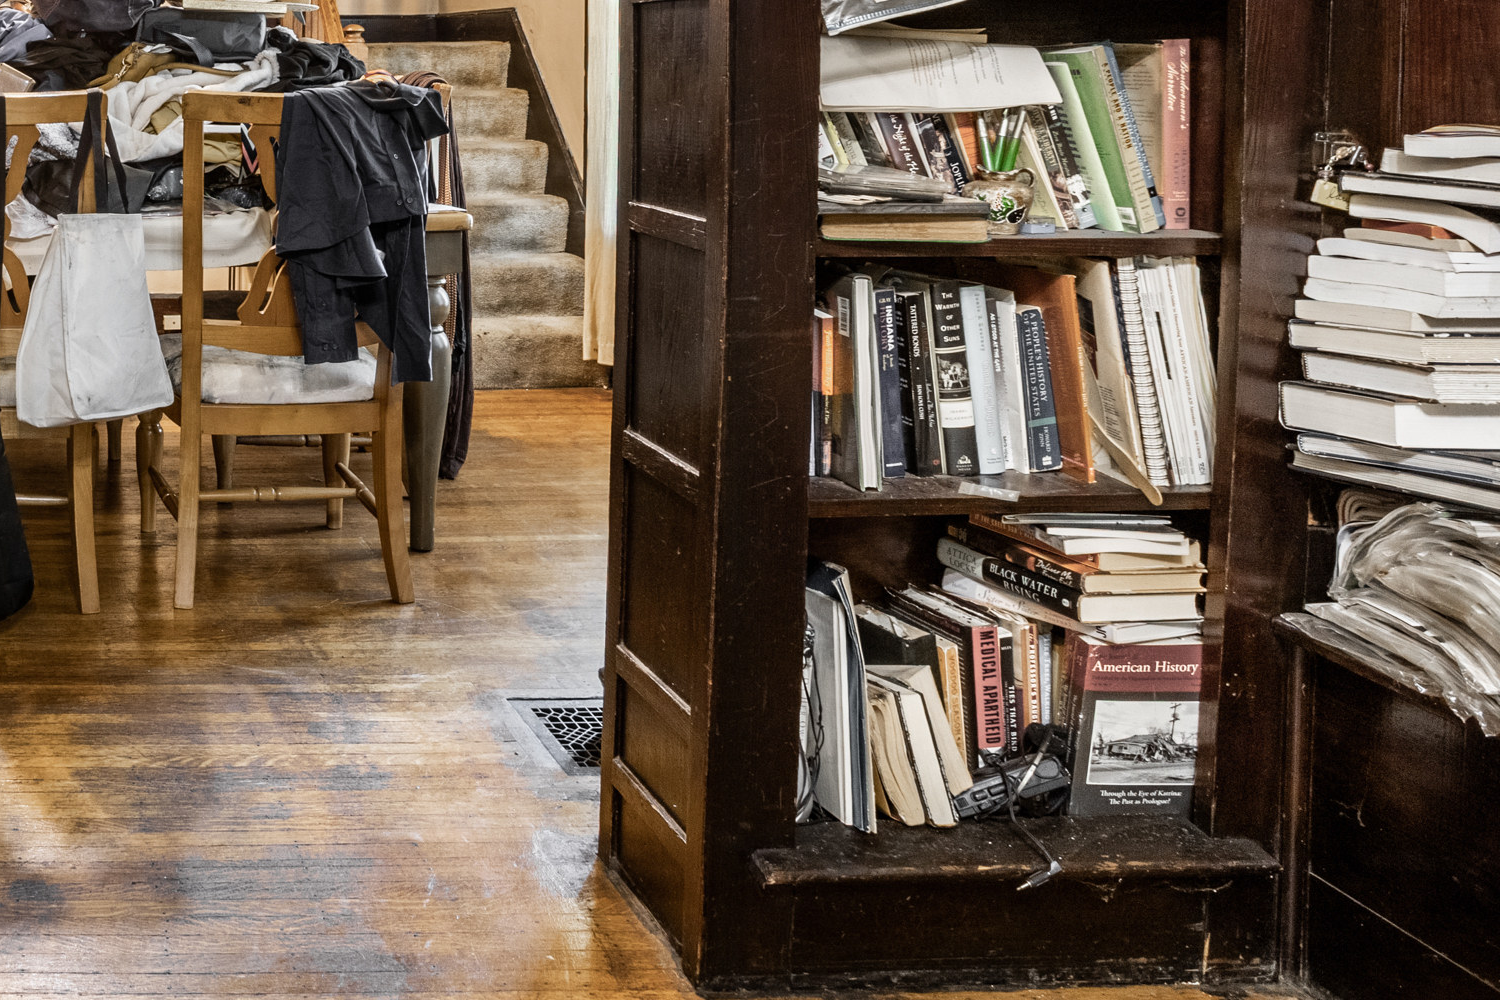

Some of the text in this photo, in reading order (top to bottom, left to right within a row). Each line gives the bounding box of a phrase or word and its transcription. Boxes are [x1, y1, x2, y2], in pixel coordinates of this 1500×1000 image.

[1166, 62, 1179, 111] Narrative
[1179, 58, 1189, 130] Bondwoman's
[1105, 69, 1117, 95] PEOPLE
[1113, 98, 1122, 114] AND
[1119, 123, 1132, 149] NATION
[892, 124, 907, 145] Night
[903, 151, 913, 162] the
[909, 304, 919, 334] TATTERED
[934, 302, 960, 311] WARMTH
[990, 312, 996, 321] AS
[879, 306, 888, 351] HISTORY
[885, 305, 895, 351] INDIANA
[940, 324, 961, 333] OTHER
[943, 335, 961, 343] SUNS
[1031, 322, 1042, 361] PEOPLE'S
[912, 335, 920, 357] BONDS
[1023, 314, 1042, 418] OF THE UNITED STATES
[822, 376, 831, 387] Key
[1036, 363, 1048, 402] HISTORY
[1043, 426, 1052, 453] HOWARD
[946, 547, 977, 566] ATTICA
[949, 557, 977, 576] LOCKE
[1035, 559, 1060, 575] Deliver
[989, 563, 1058, 599] BLACK WATER
[1003, 580, 1041, 603] RISING
[1029, 645, 1037, 699] PROFESSOR'S
[1092, 661, 1198, 675] American History
[948, 655, 962, 735] VOODOO SEASON
[980, 630, 1001, 744] MEDICAL APARTHEID
[1009, 707, 1017, 728] THAT
